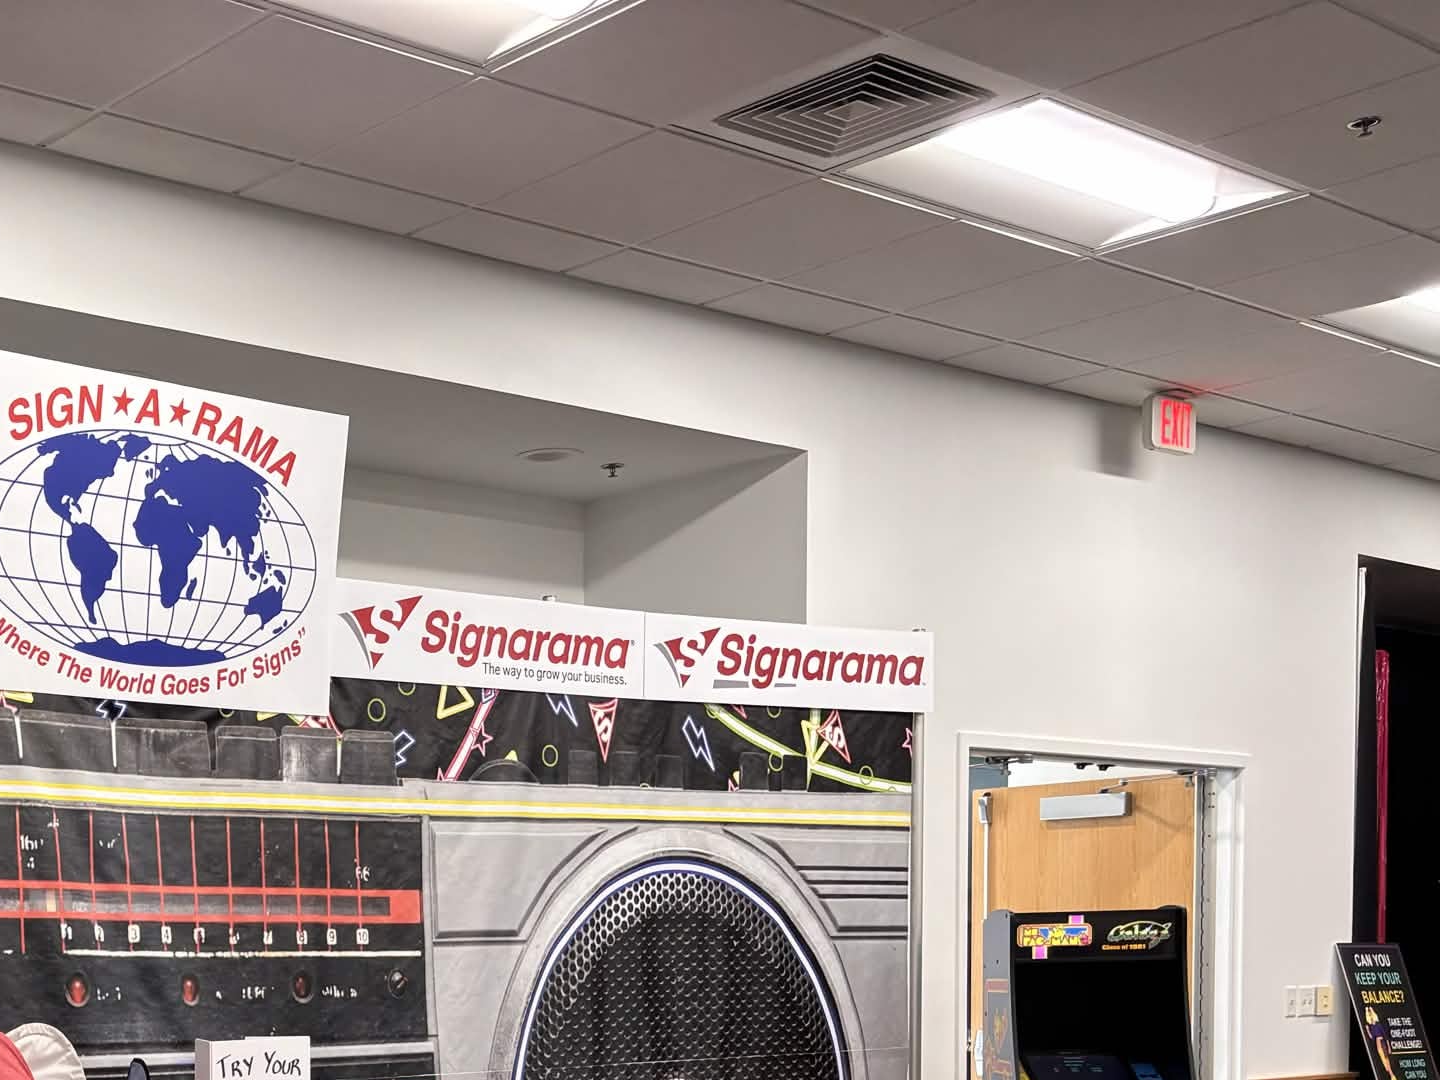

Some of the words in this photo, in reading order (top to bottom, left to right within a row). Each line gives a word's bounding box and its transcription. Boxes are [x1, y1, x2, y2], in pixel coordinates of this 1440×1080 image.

[7, 384, 107, 442] SIGN
[191, 400, 298, 488] RAMA
[1161, 399, 1193, 448] EXIT
[421, 609, 630, 668] Signarama
[57, 652, 93, 684] The
[99, 669, 156, 696] World
[160, 674, 210, 697] Goes
[216, 667, 247, 691] For
[482, 662, 501, 676] The
[503, 666, 522, 679] way
[524, 667, 535, 678] to
[536, 670, 559, 682] grow
[560, 672, 583, 684] your
[584, 672, 628, 685] business.
[717, 633, 926, 689] Signarama
[1354, 954, 1373, 968] CAN
[1372, 953, 1391, 967] YOU
[1355, 972, 1377, 986] KEEP
[1377, 971, 1402, 985] YOUR
[1361, 990, 1405, 1004] BALANCE?
[216, 1054, 254, 1079] TRY
[264, 1051, 302, 1077] YOUR
